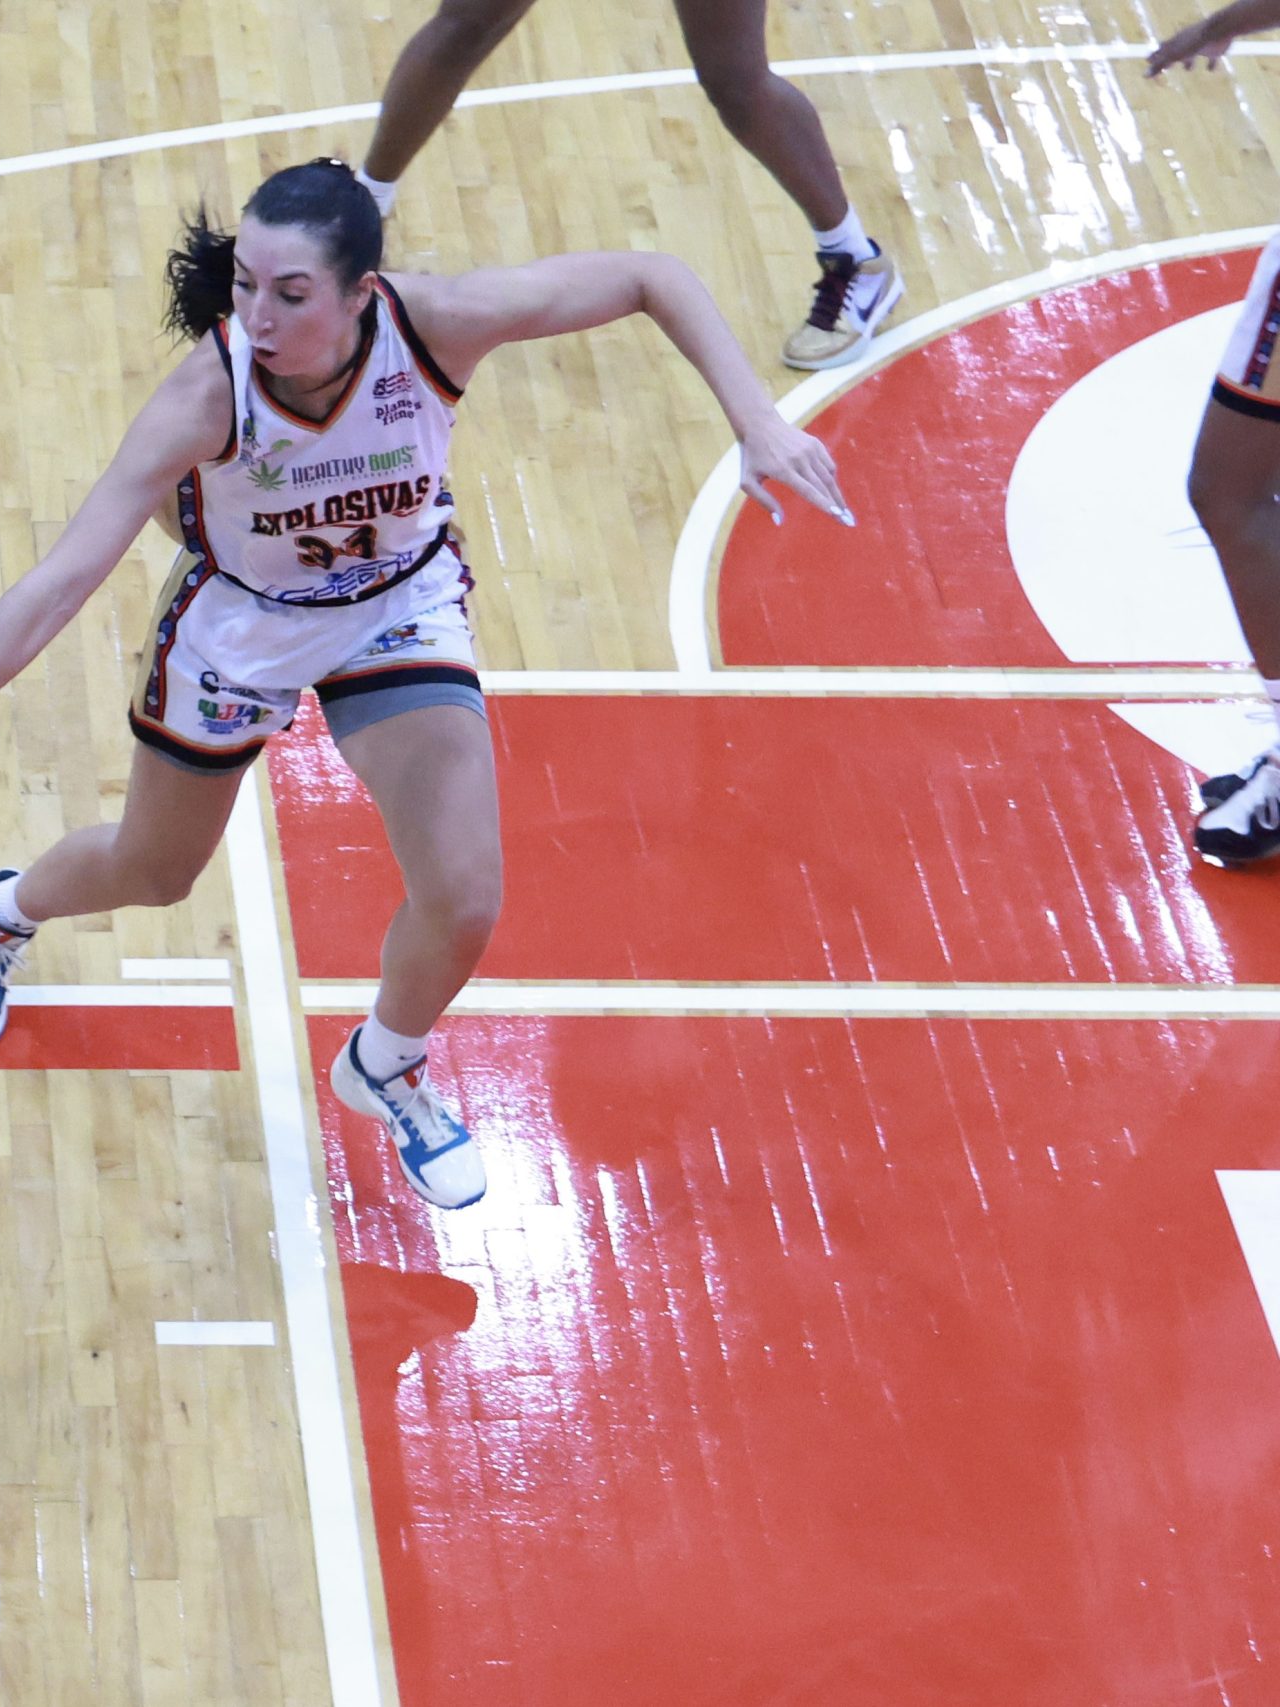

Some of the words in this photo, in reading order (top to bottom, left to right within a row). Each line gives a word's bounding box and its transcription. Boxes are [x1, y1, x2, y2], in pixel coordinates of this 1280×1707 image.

[291, 455, 366, 485] HEALTHY
[368, 446, 413, 472] BUDS
[251, 474, 431, 536] EXPLOSIVAS
